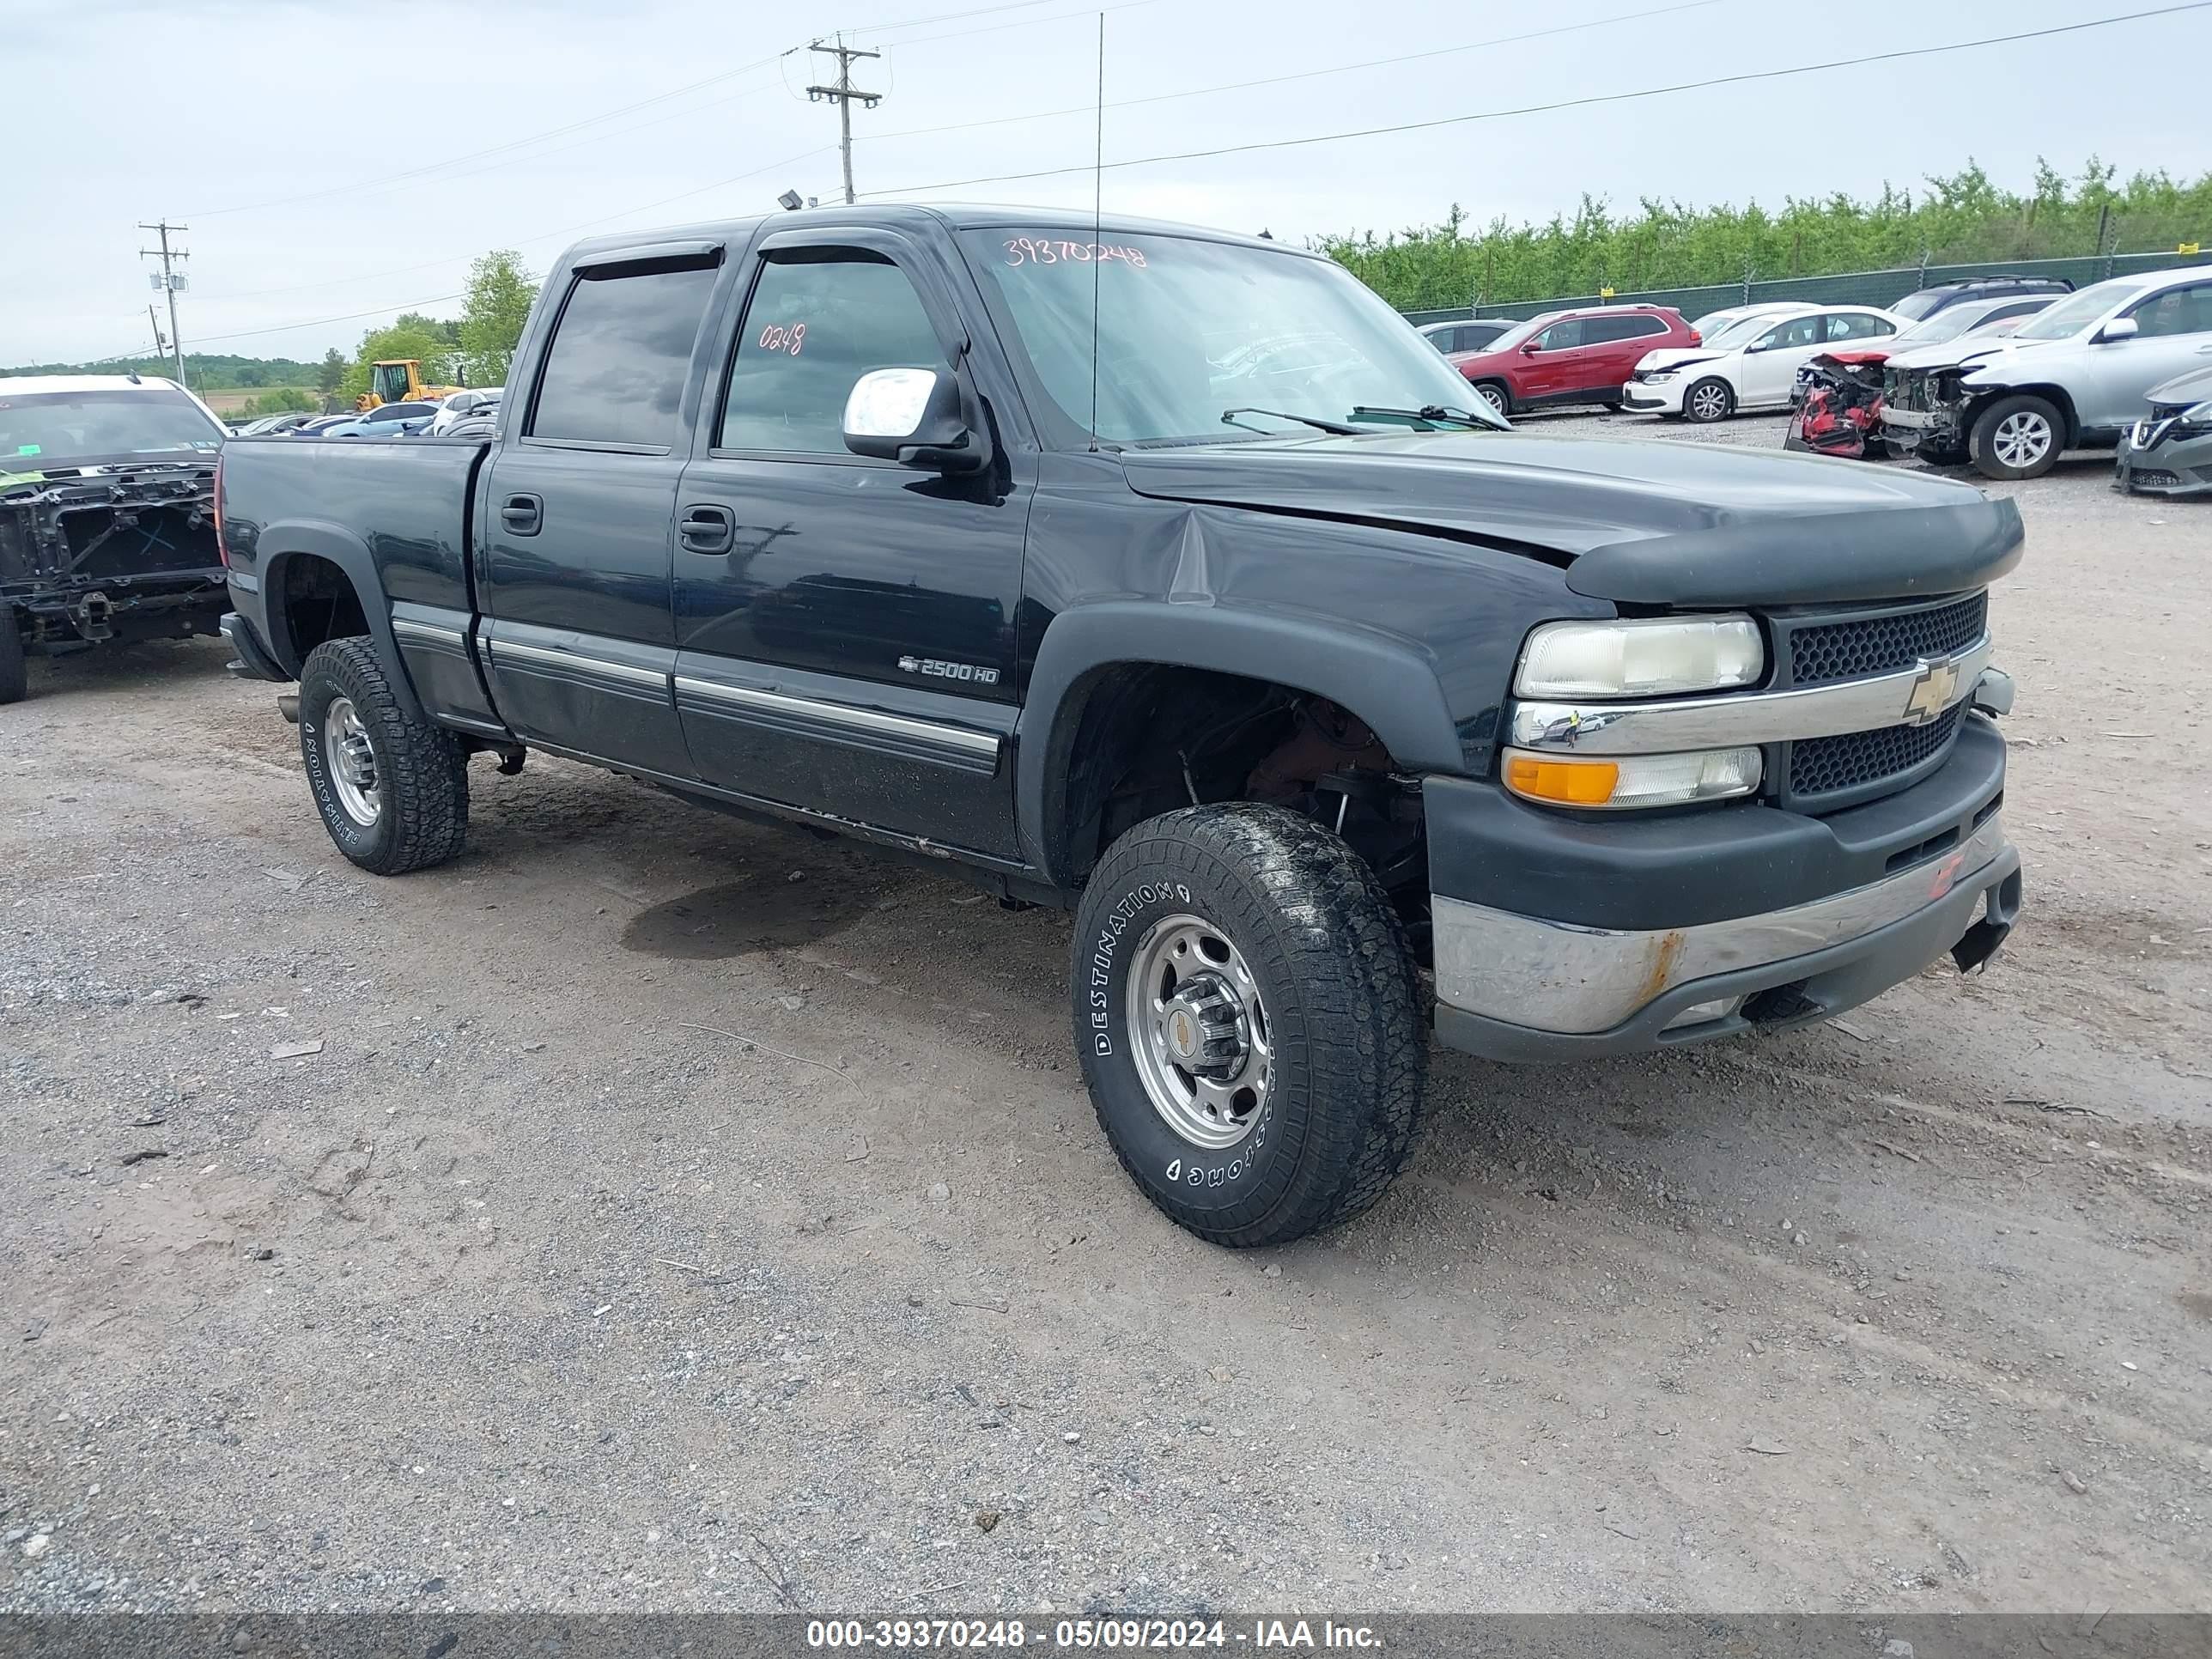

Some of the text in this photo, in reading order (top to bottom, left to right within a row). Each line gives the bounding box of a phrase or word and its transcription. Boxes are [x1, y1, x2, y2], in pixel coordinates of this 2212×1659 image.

[1002, 237, 1148, 269] 39370248
[759, 323, 805, 356] 0248
[921, 659, 998, 684] 2500 HD
[306, 737, 362, 846] DESTINATION
[1090, 881, 1175, 1056] DESTINATION
